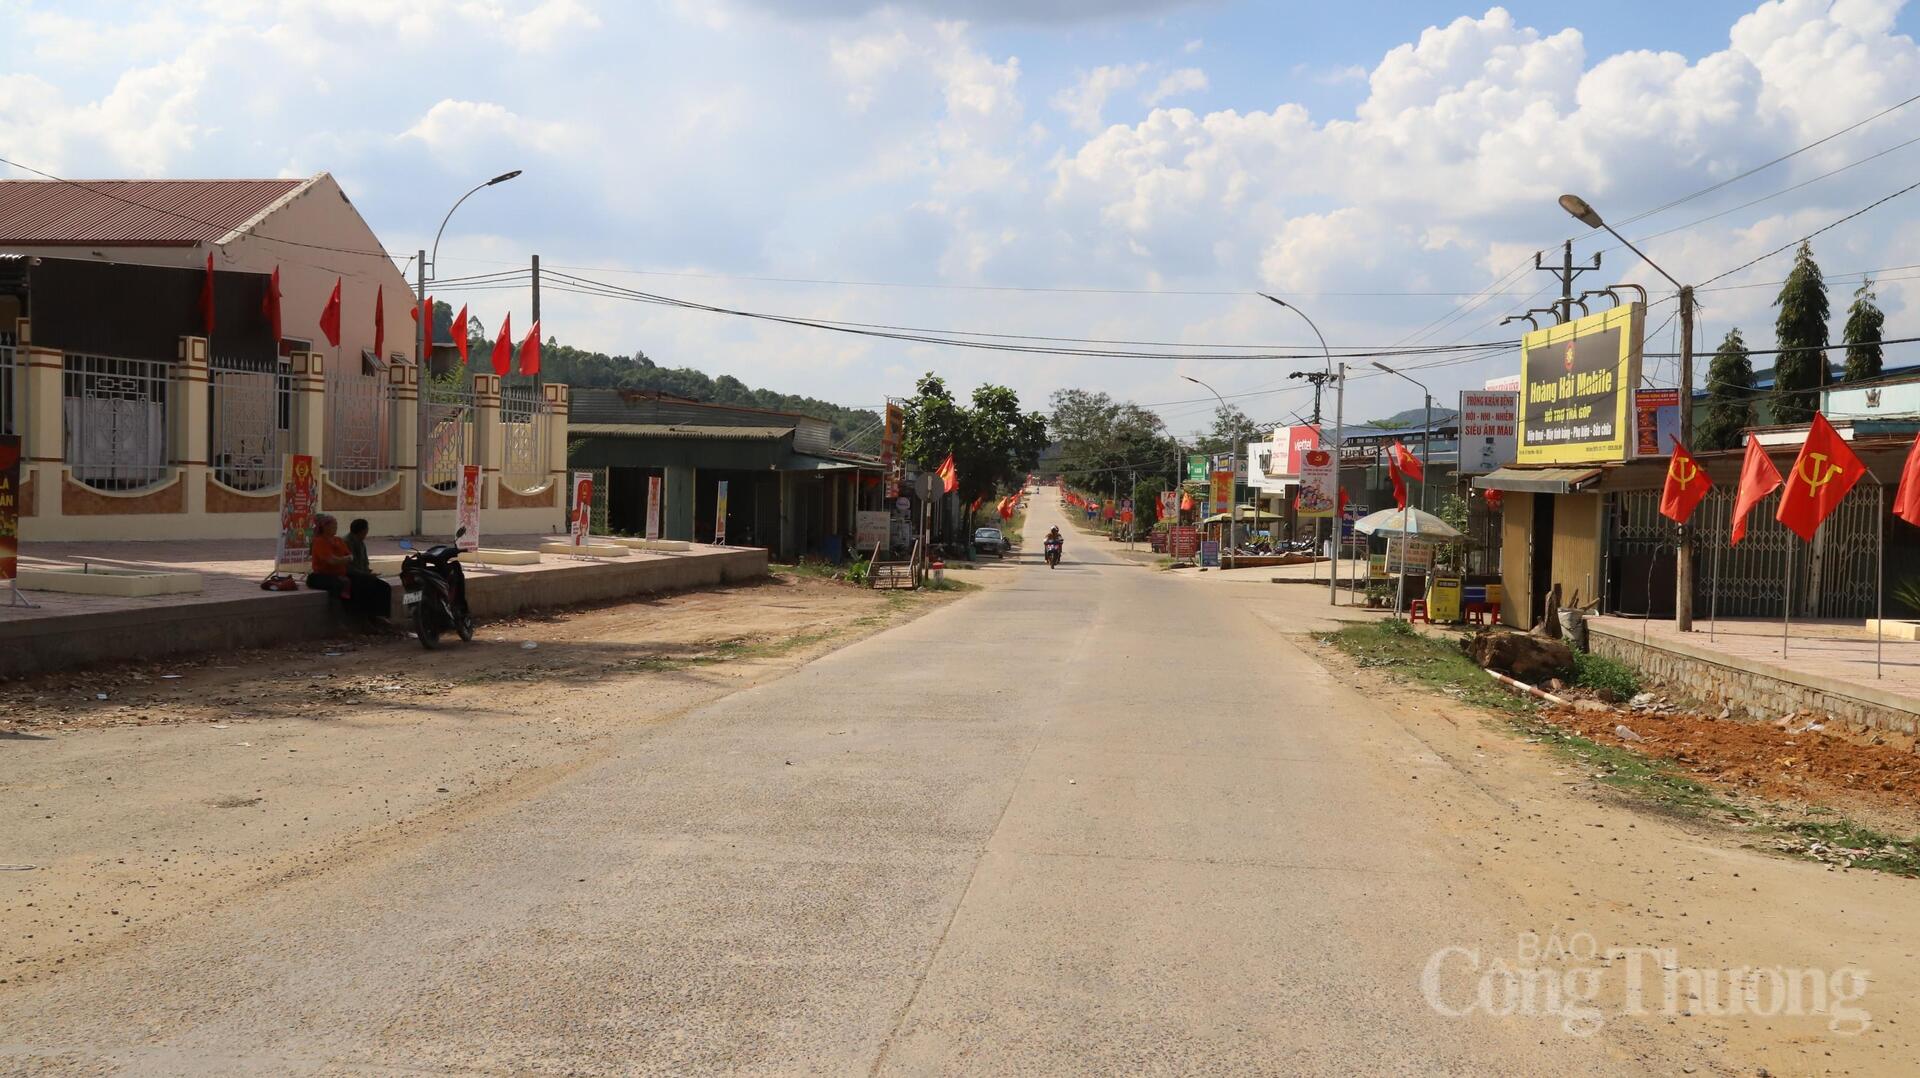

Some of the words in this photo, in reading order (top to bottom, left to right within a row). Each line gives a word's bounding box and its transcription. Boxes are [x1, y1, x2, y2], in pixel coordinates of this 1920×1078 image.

[1530, 380, 1557, 403] Hoàng
[1559, 373, 1575, 399] Hải
[1577, 369, 1612, 397] Mobile
[1481, 412, 1491, 421] NHI
[1465, 423, 1482, 436] SIÊU
